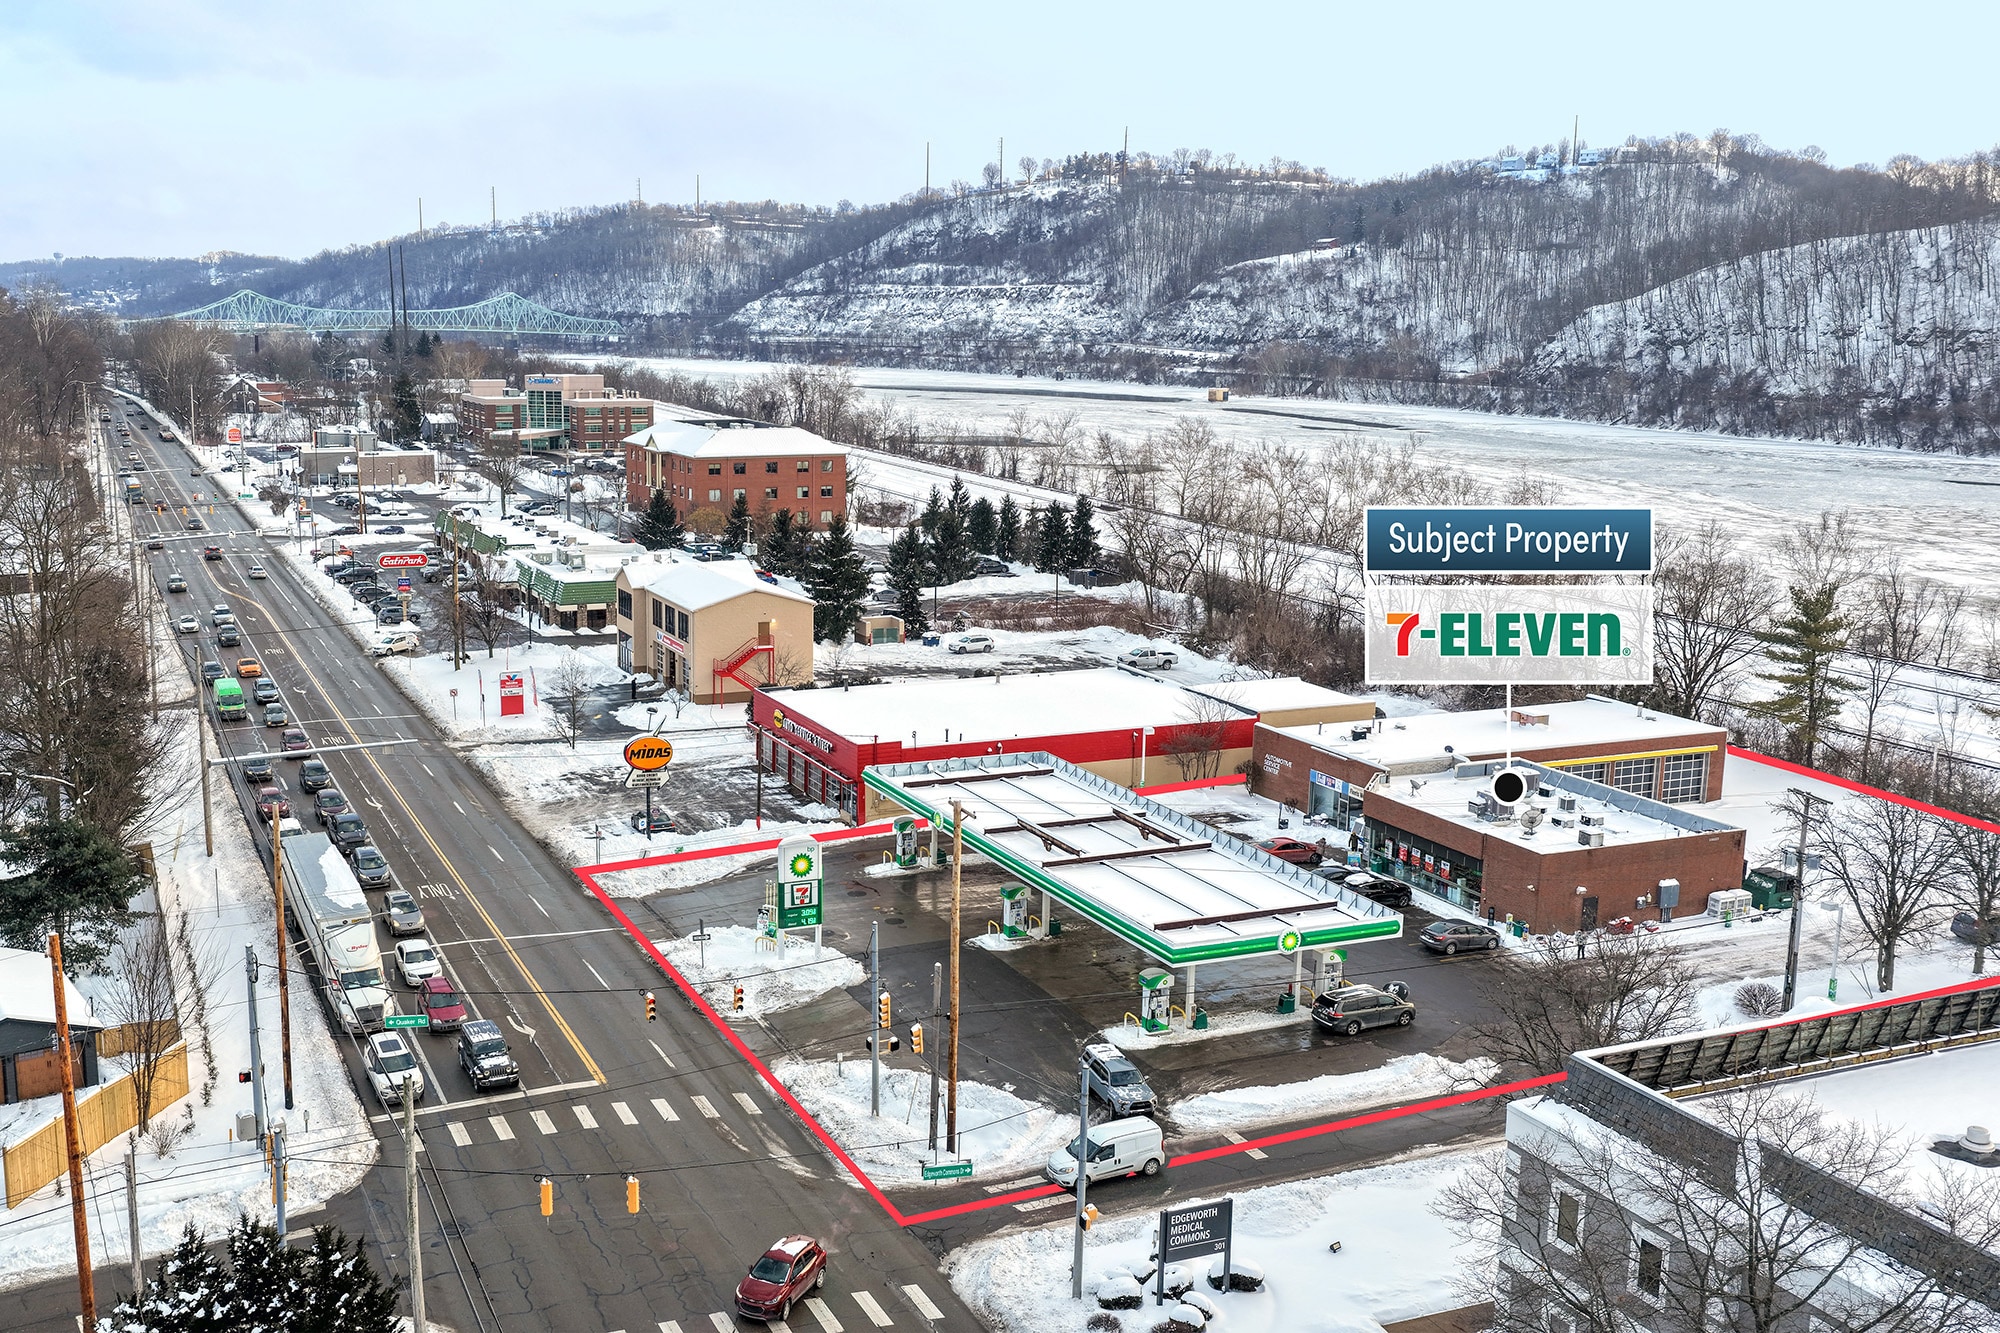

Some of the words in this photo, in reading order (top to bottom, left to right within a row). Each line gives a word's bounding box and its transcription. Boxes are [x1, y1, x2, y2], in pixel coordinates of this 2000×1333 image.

[321, 735, 347, 746] ONLY
[630, 747, 671, 761] MIDAS
[1264, 753, 1293, 769] AUTOMOTIVE
[1262, 765, 1279, 776] CENTER
[1263, 759, 1281, 770] SERVICE
[417, 883, 453, 899] ONLY
[924, 1170, 943, 1179] Edgeworth
[943, 1168, 960, 1176] Commons
[1171, 1207, 1218, 1225] EDGEWORTH
[1170, 1220, 1204, 1236] MEDICAL
[1169, 1229, 1211, 1246] COMMONS
[1213, 1241, 1225, 1251] 301
